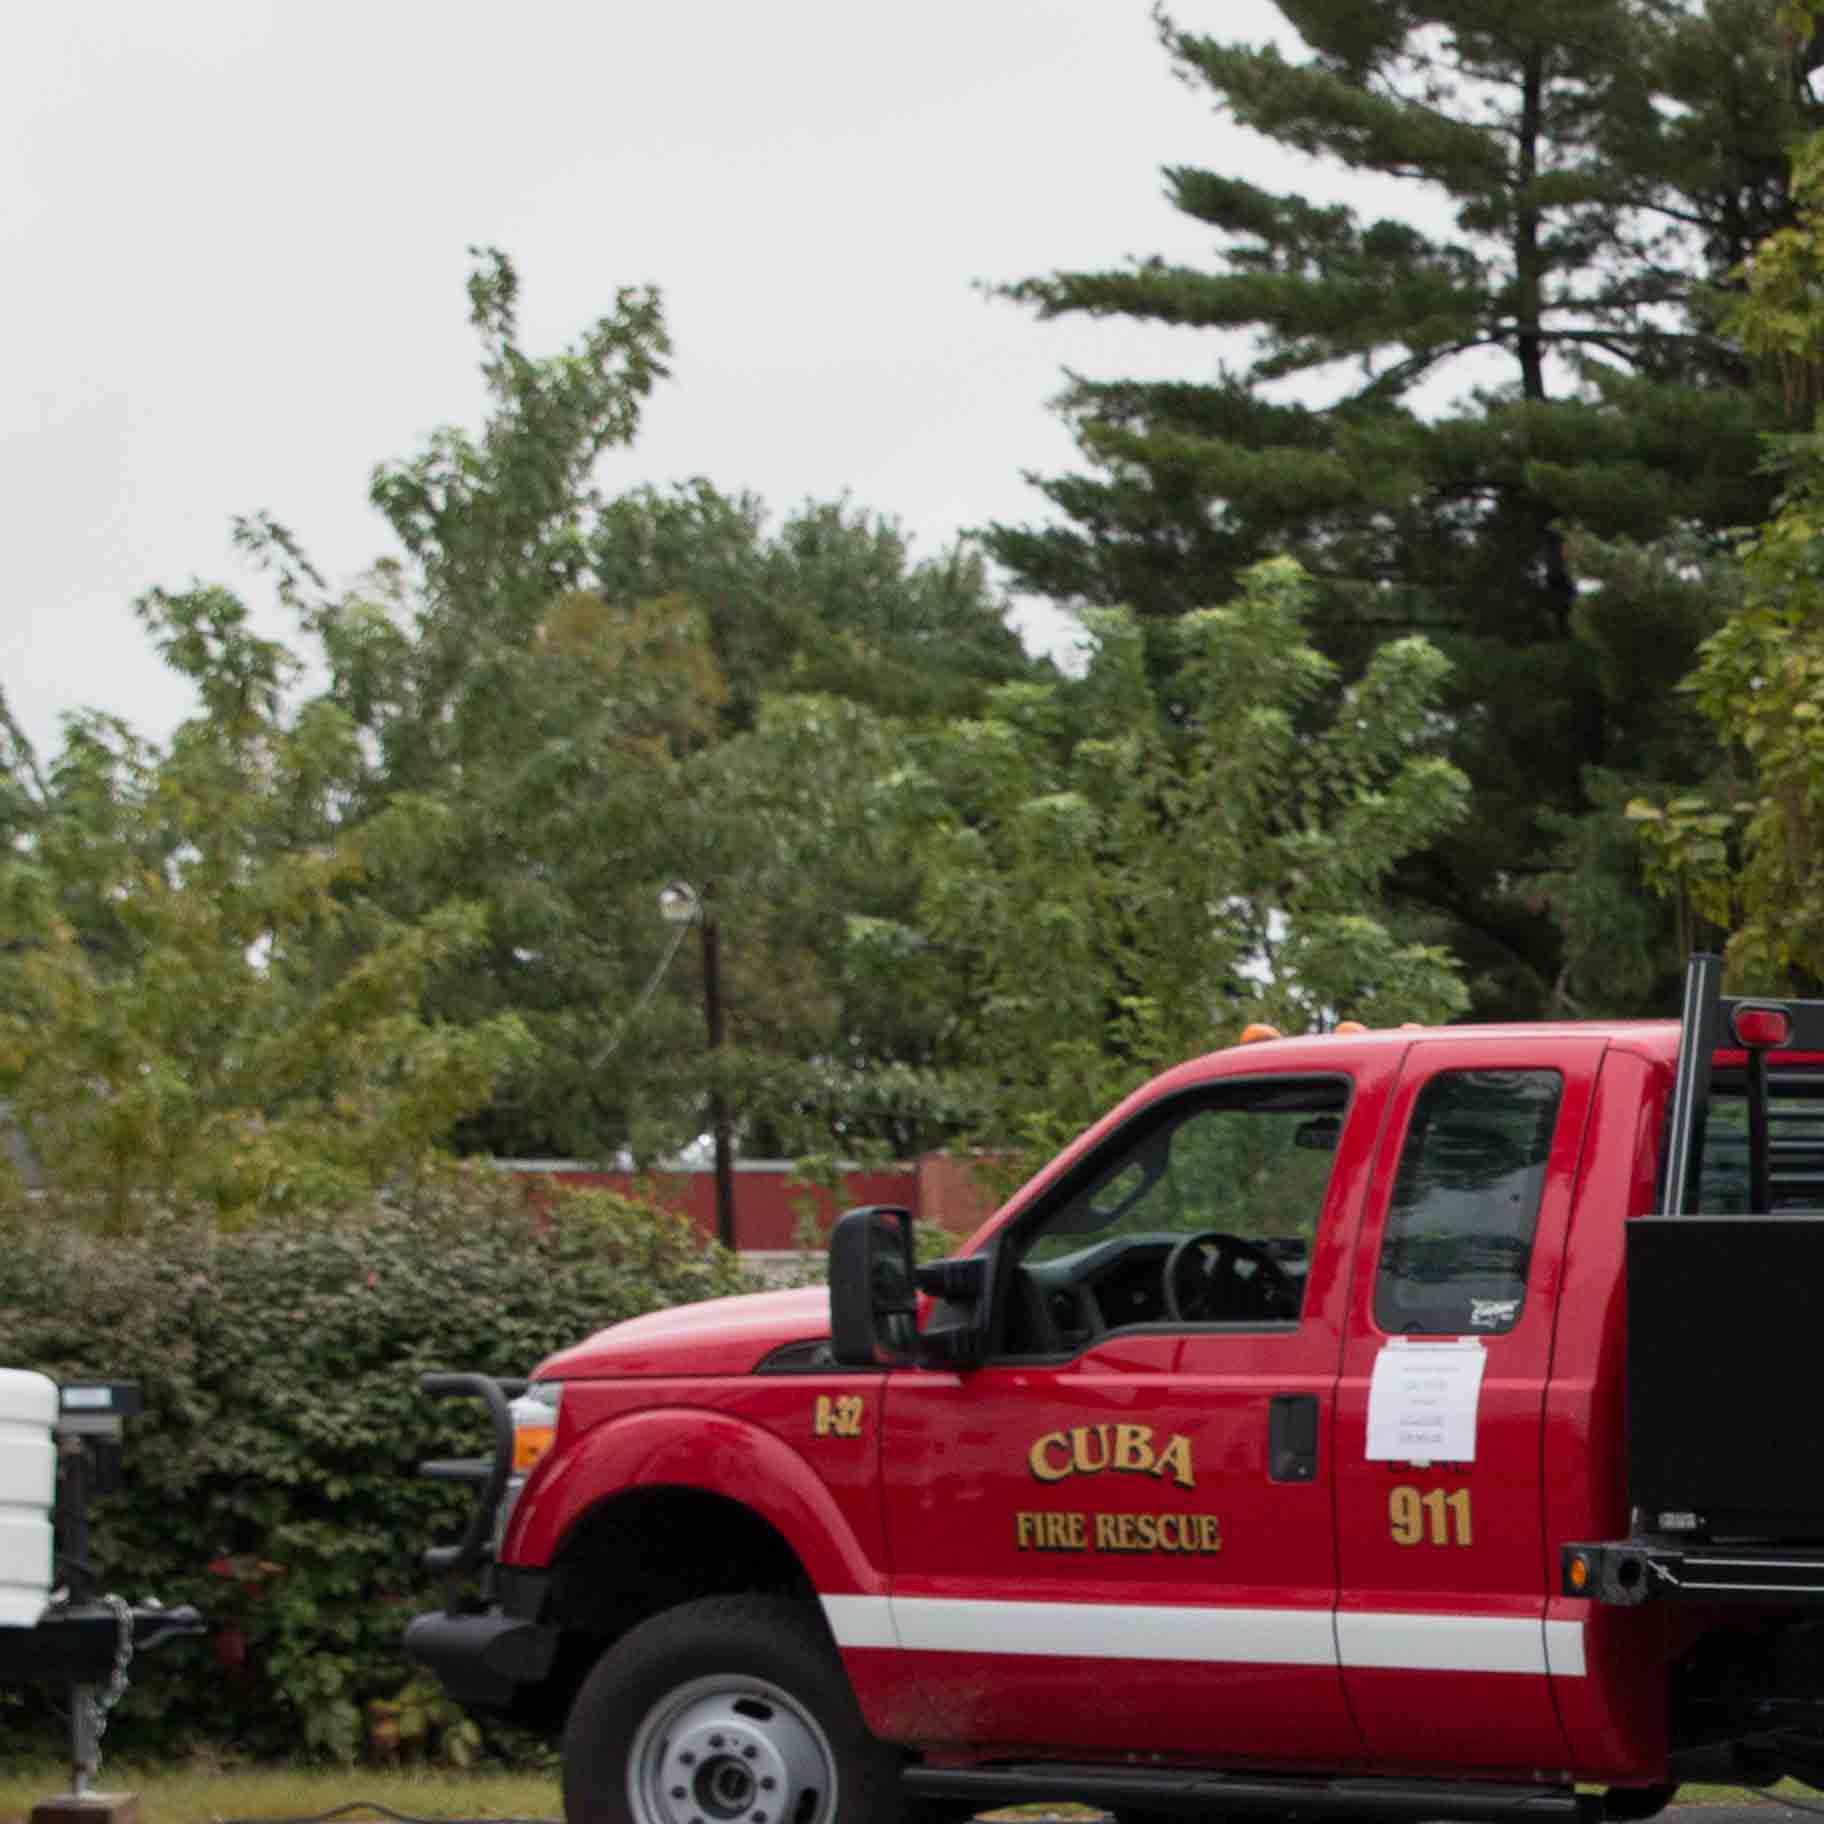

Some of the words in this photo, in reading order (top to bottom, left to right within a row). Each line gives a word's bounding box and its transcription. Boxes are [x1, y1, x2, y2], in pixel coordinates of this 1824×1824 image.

[1028, 1423, 1196, 1490] CUBA
[1015, 1511, 1088, 1551] FIRE
[1094, 1512, 1222, 1555] RESCUE
[1388, 1485, 1473, 1547] 911
